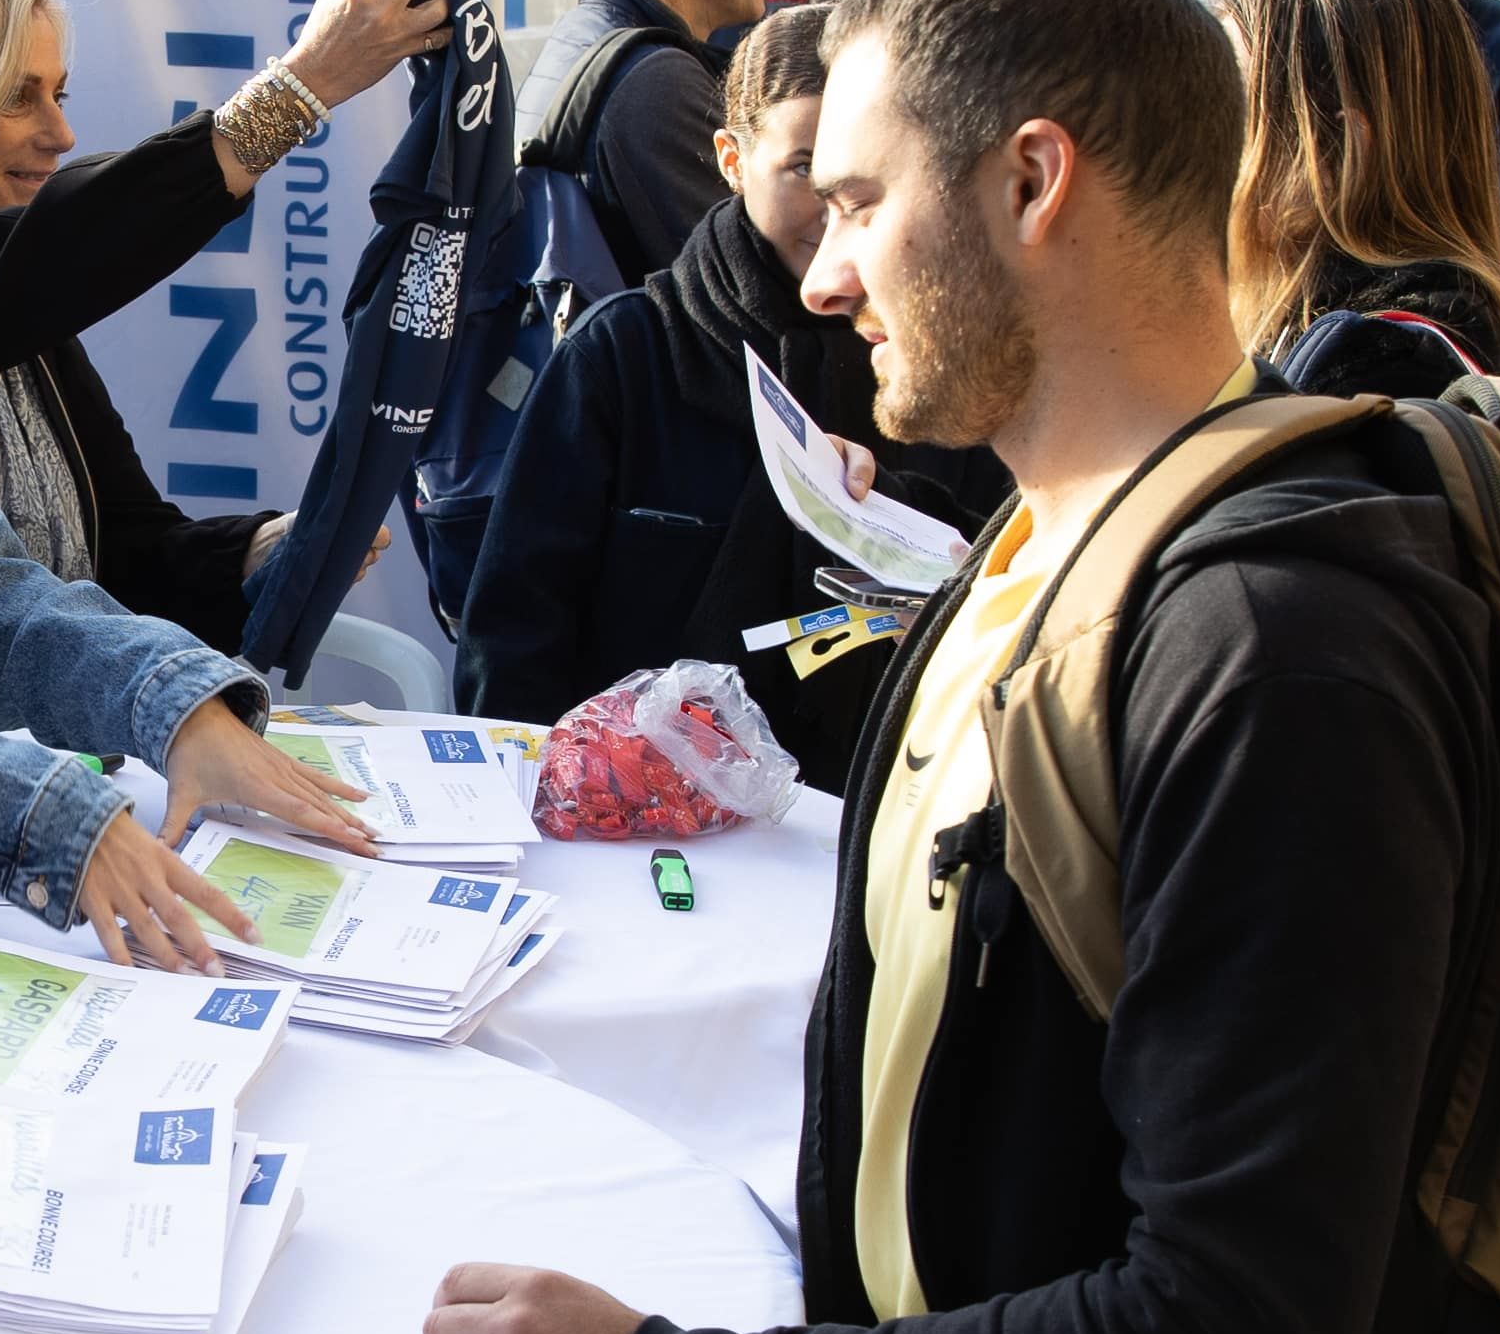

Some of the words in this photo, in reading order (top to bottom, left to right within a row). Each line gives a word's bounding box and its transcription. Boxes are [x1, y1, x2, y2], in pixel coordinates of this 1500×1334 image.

[457, 62, 498, 131] et
[371, 401, 434, 424] VINC
[280, 893, 330, 931] YANN
[41, 1188, 65, 1229] BONNE
